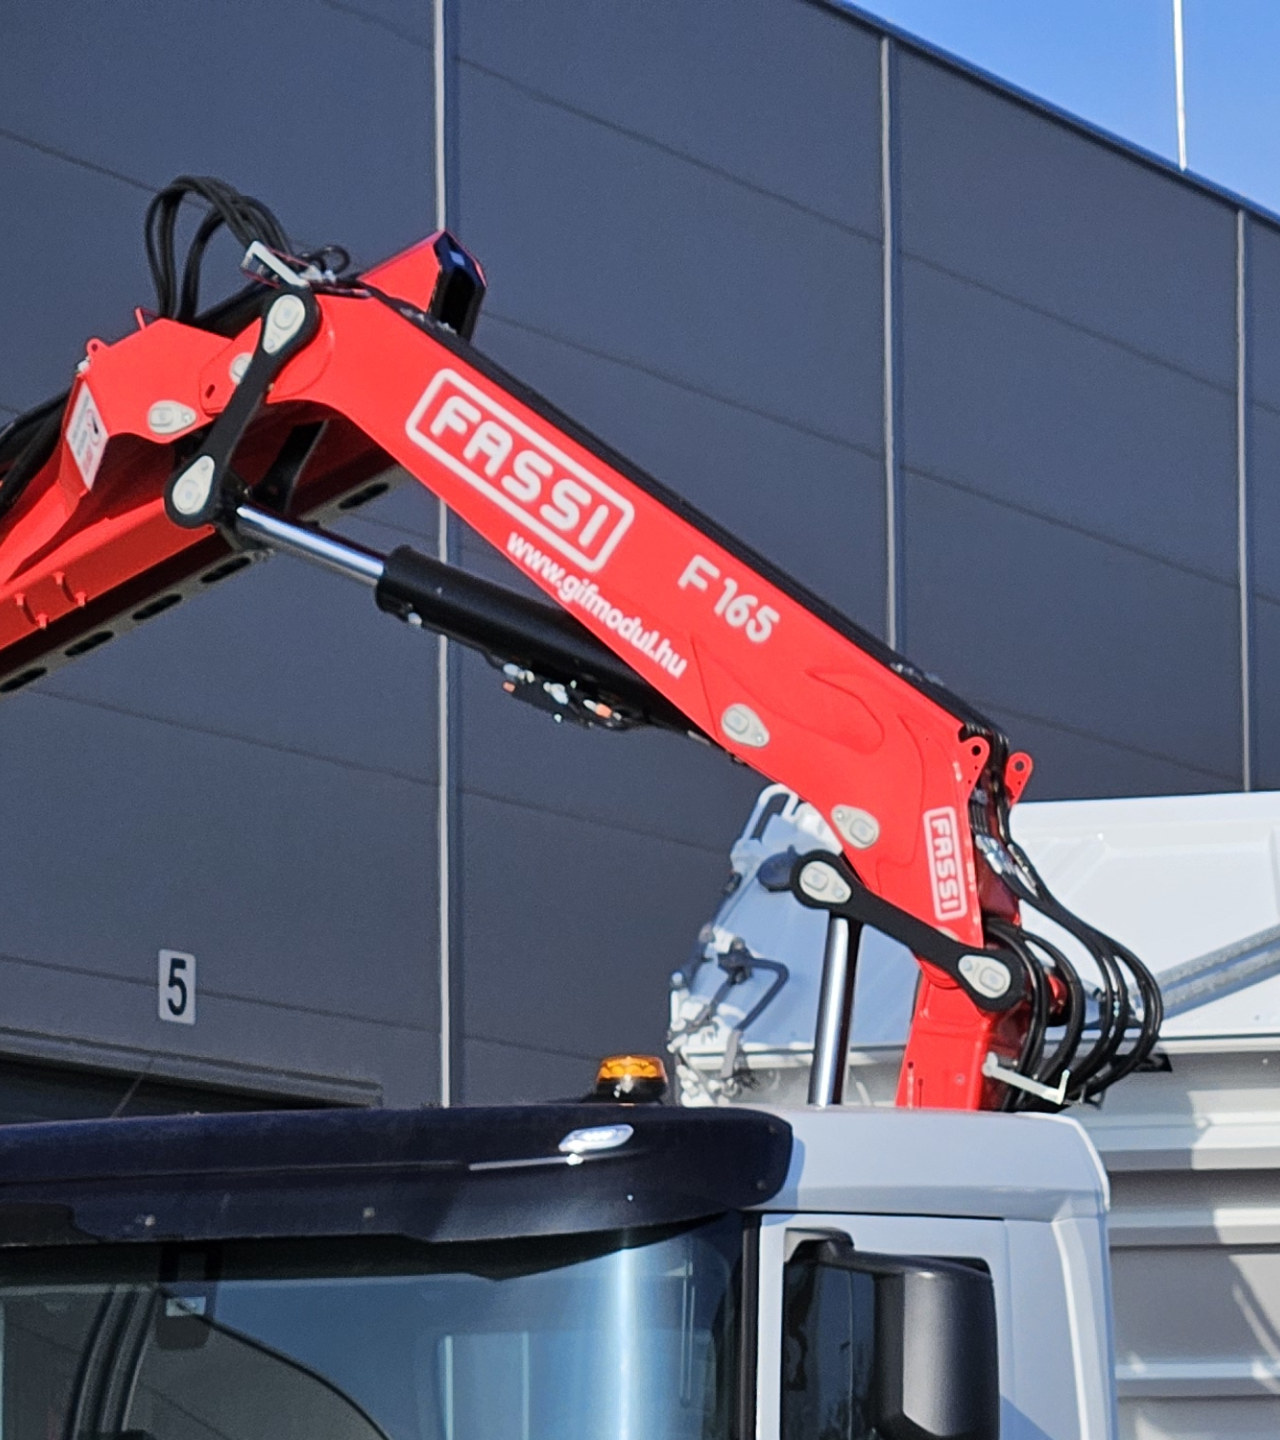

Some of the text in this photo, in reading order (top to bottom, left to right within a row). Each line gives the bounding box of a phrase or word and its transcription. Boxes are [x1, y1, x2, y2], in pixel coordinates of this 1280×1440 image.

[429, 394, 611, 549] FASSI
[505, 531, 688, 680] www.gifmodul.hu
[930, 817, 960, 911] FASSI
[167, 958, 188, 1016] 5
